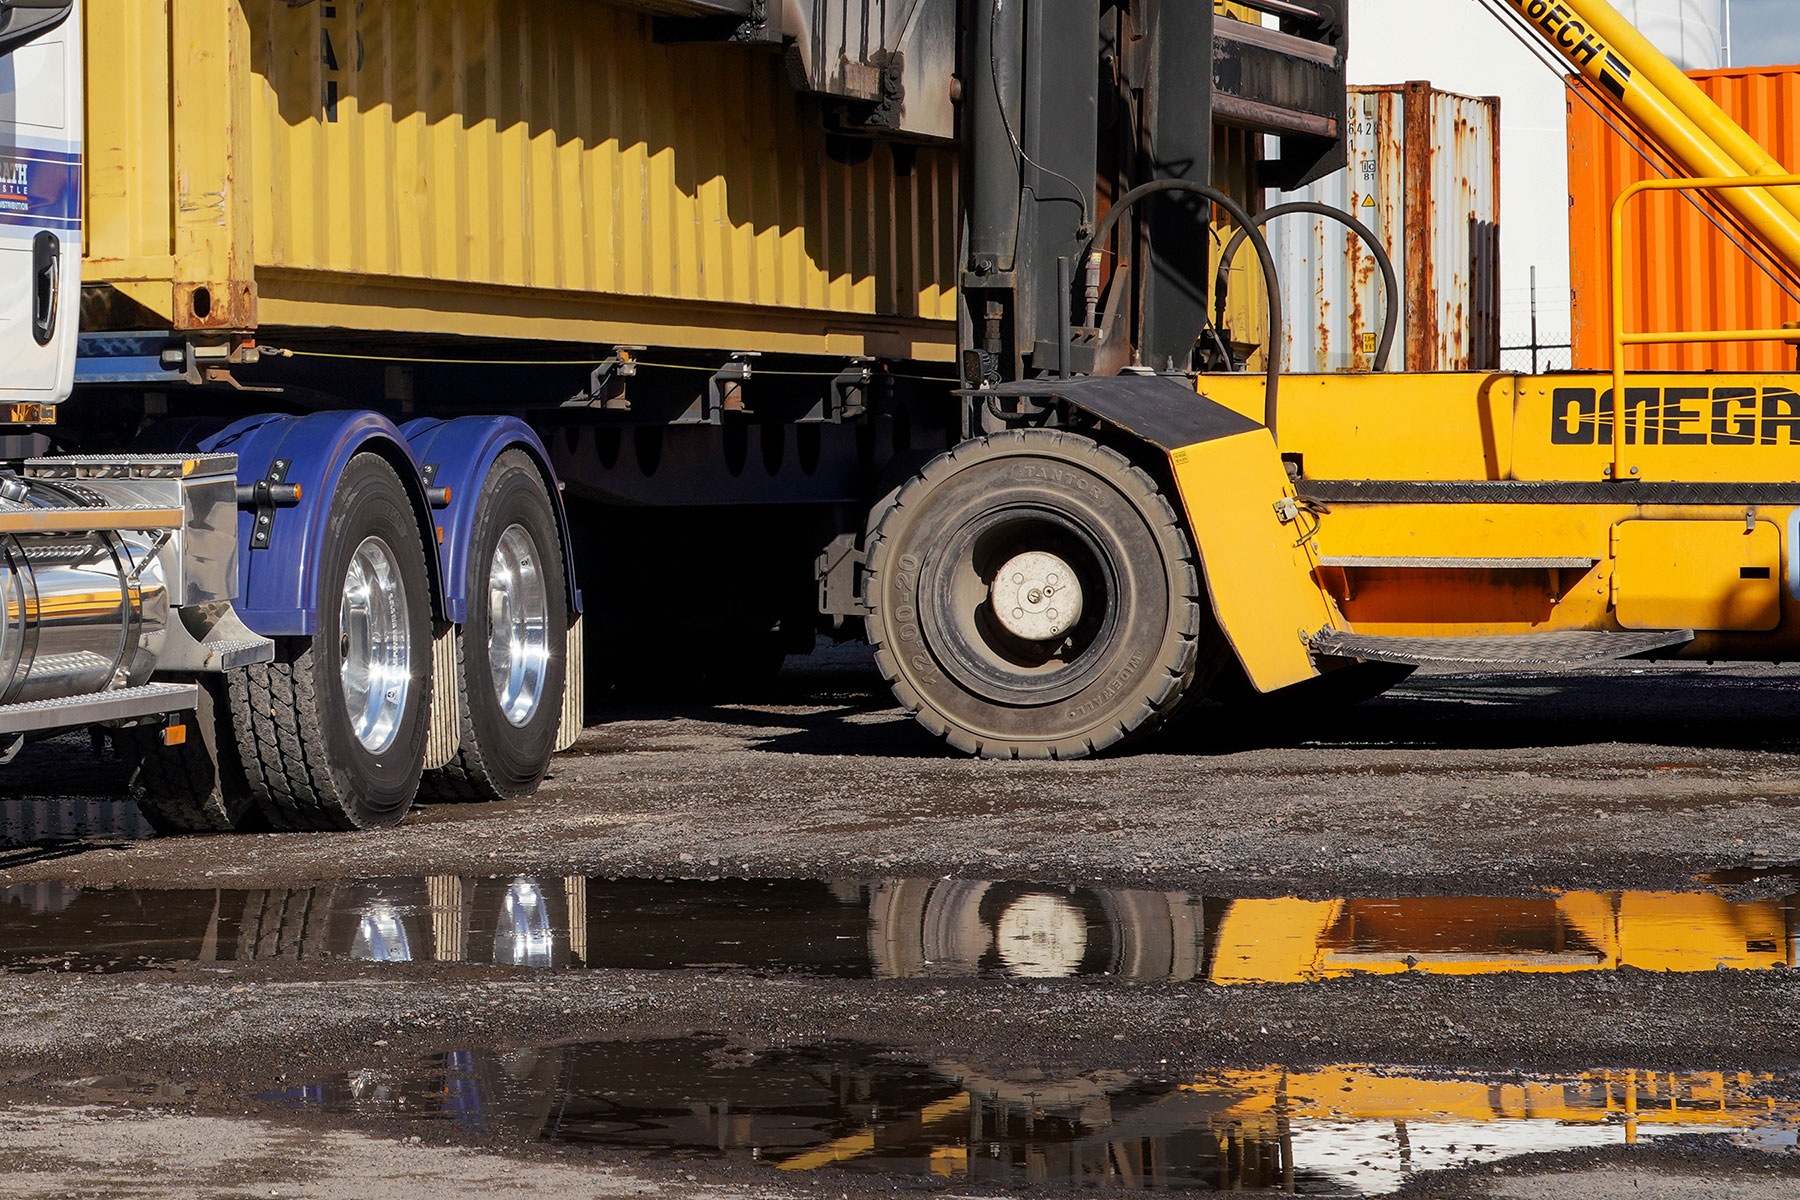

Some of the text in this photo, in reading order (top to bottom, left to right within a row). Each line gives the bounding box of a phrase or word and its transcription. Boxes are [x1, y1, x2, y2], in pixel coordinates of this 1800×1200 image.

[1552, 388, 1800, 445] OMEGA
[1023, 464, 1102, 500] TANTOR
[893, 553, 939, 687] 12.00-20
